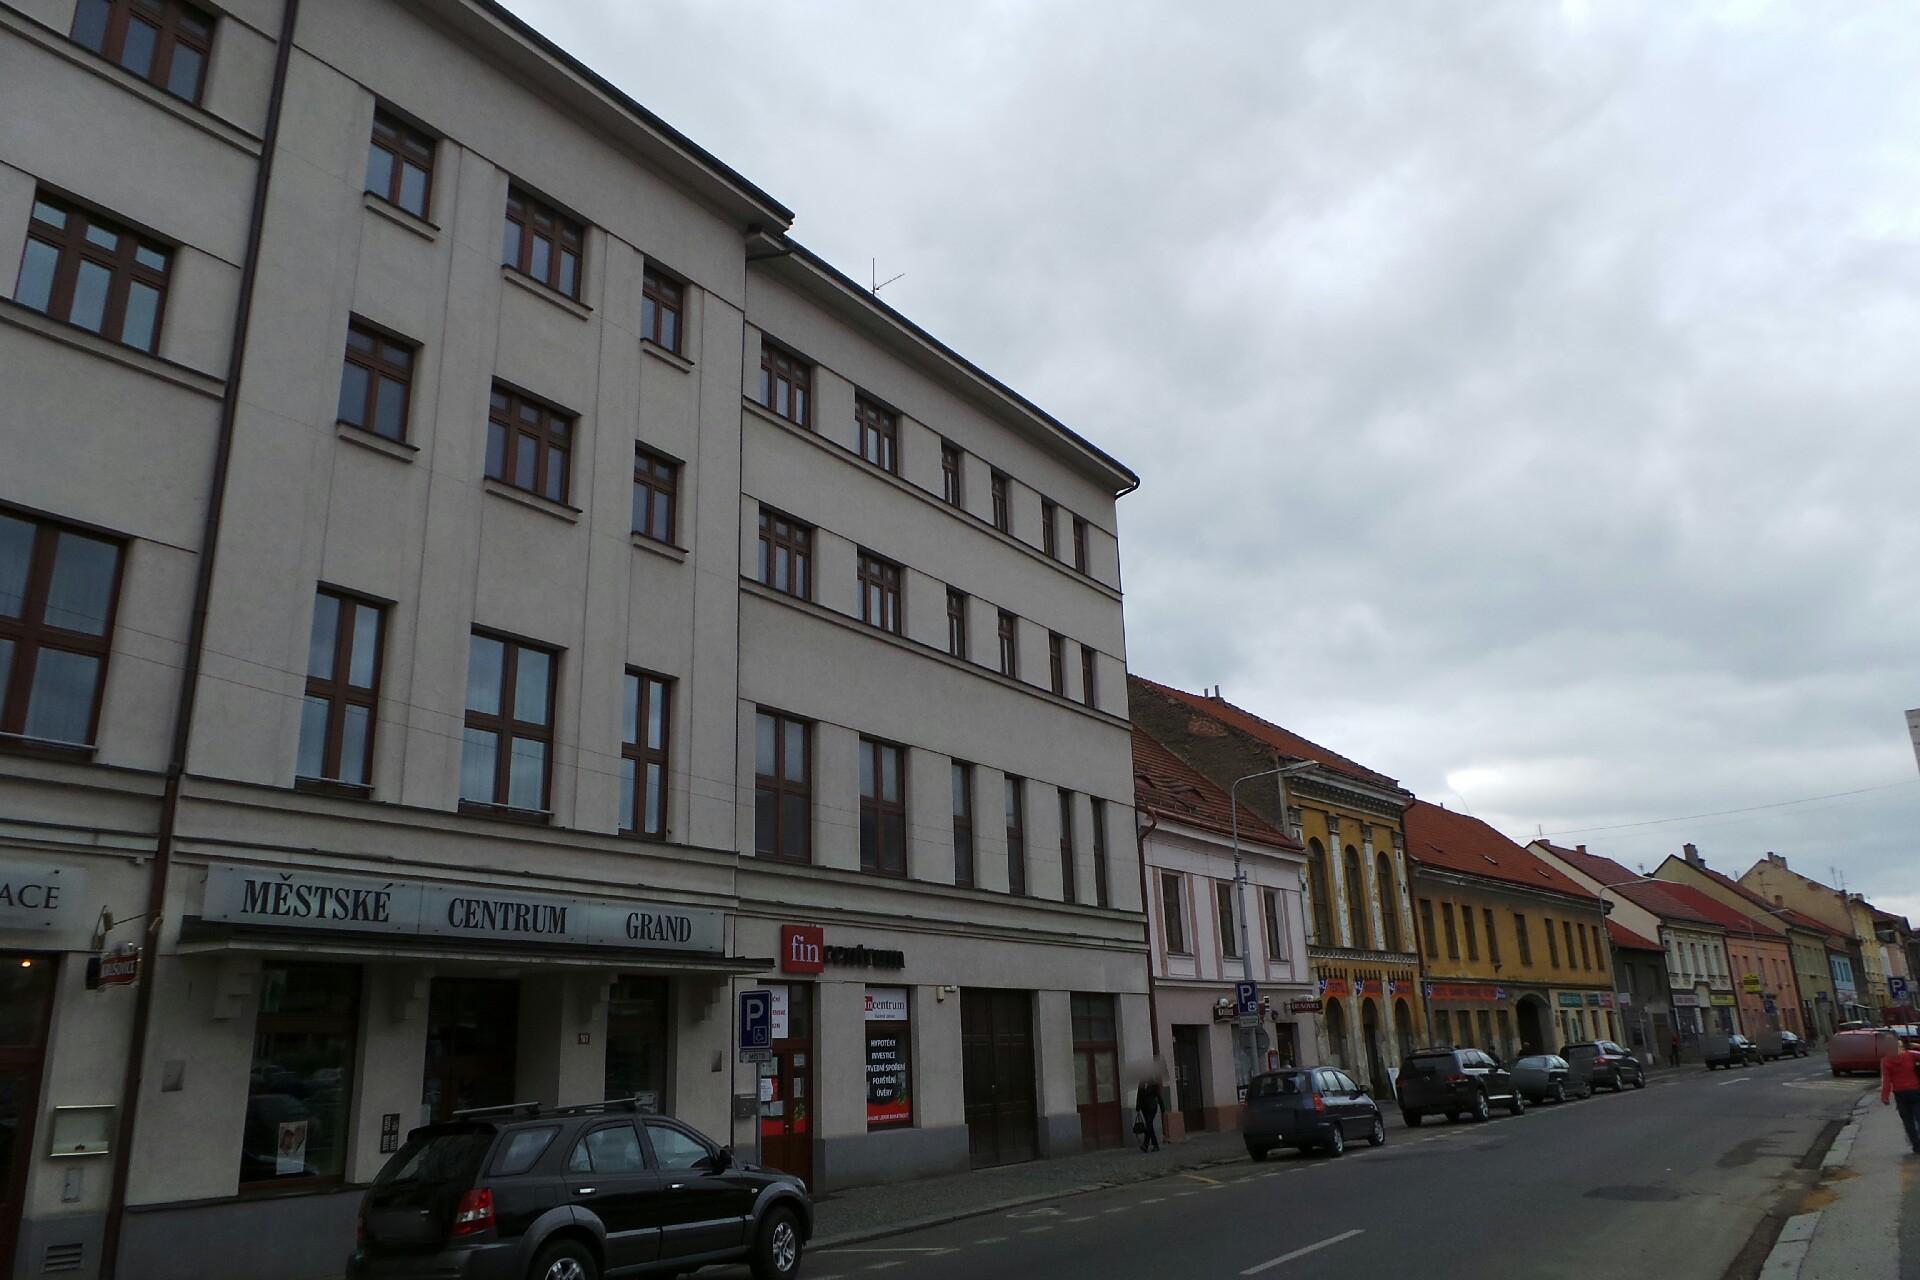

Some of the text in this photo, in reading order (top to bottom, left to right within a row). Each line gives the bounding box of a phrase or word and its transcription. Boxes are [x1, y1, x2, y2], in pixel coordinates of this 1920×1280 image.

[240, 873, 692, 942] MĚSTSKÉ CENTRUM GRAND
[1239, 984, 1253, 1004] P
[746, 998, 764, 1032] P
